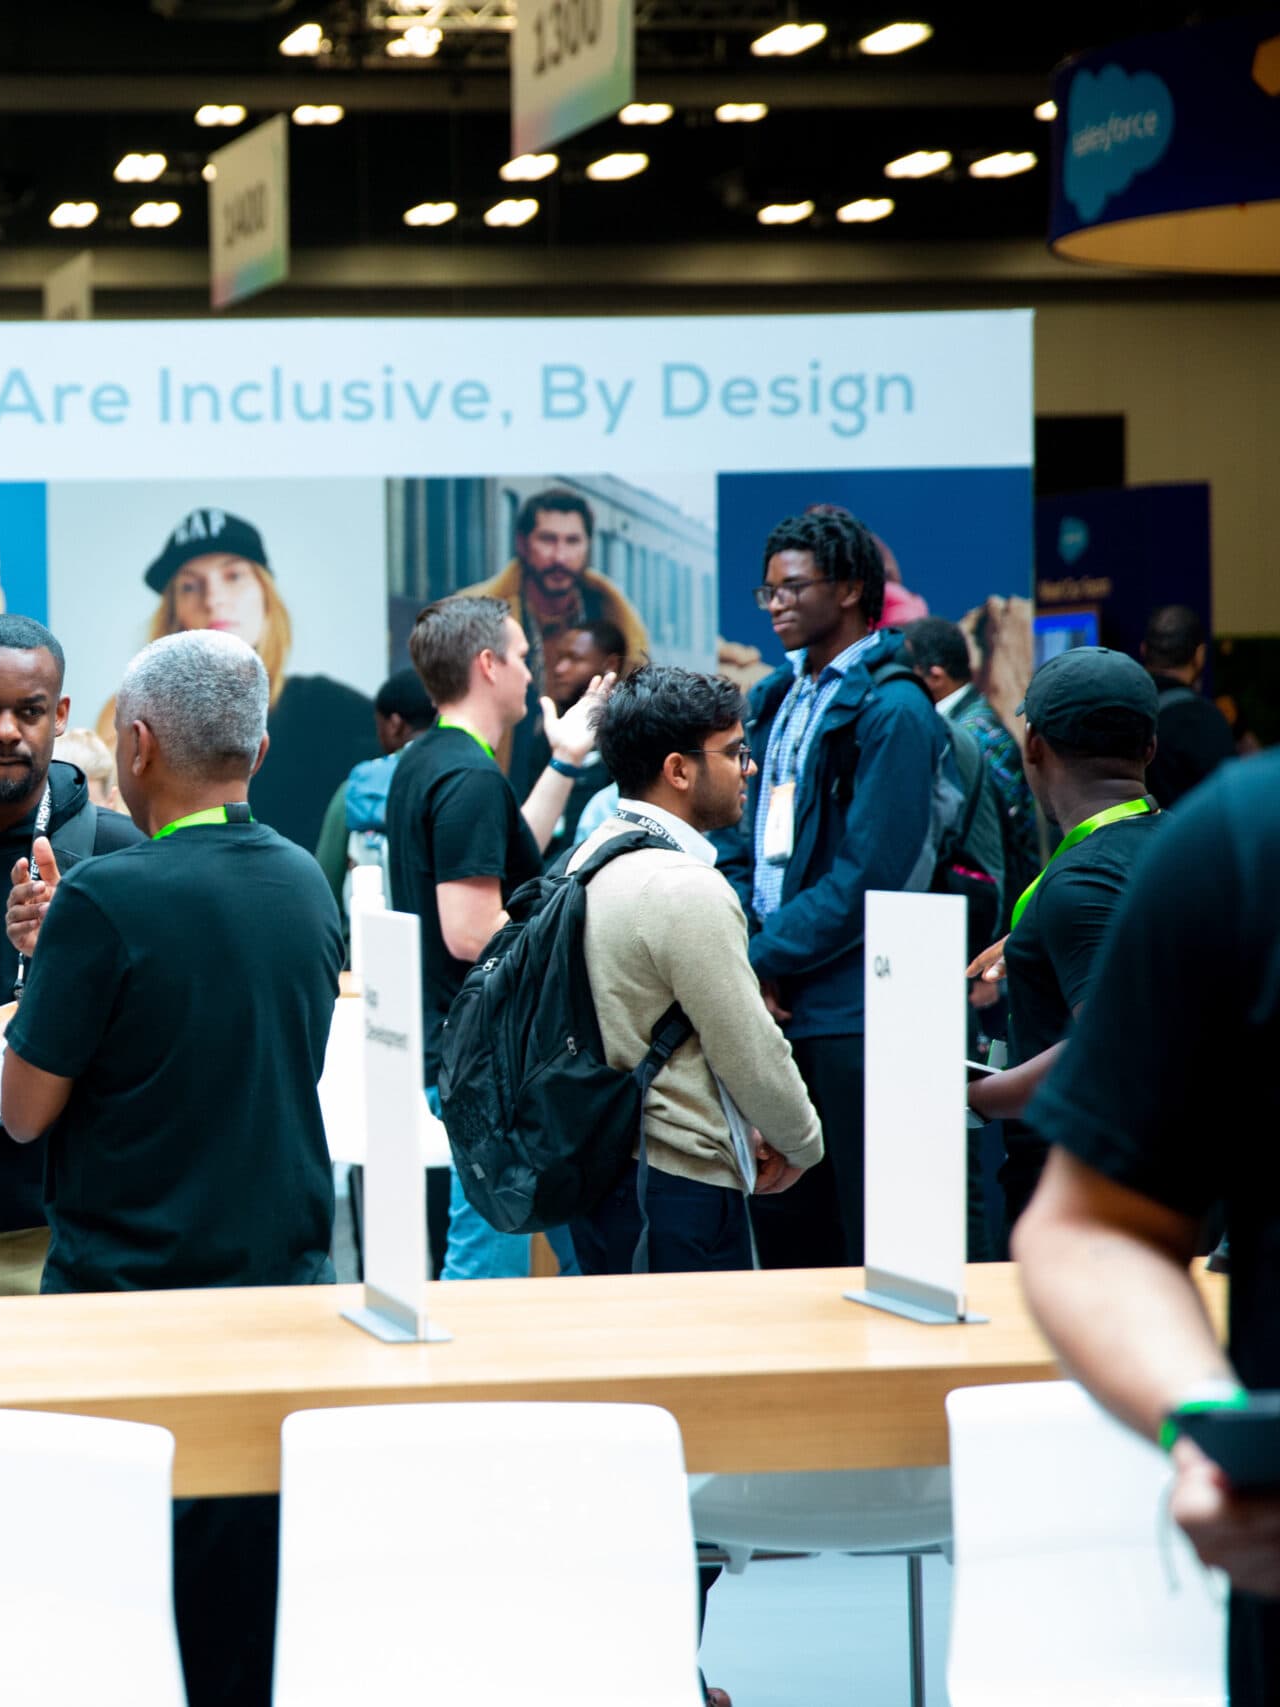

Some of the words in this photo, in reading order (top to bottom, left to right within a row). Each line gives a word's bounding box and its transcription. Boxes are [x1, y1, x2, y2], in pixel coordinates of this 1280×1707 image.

[533, 0, 602, 77] 1300
[159, 364, 513, 427] Inclusive,
[540, 363, 635, 436] By
[661, 358, 915, 440] Design
[874, 954, 891, 979] QA
